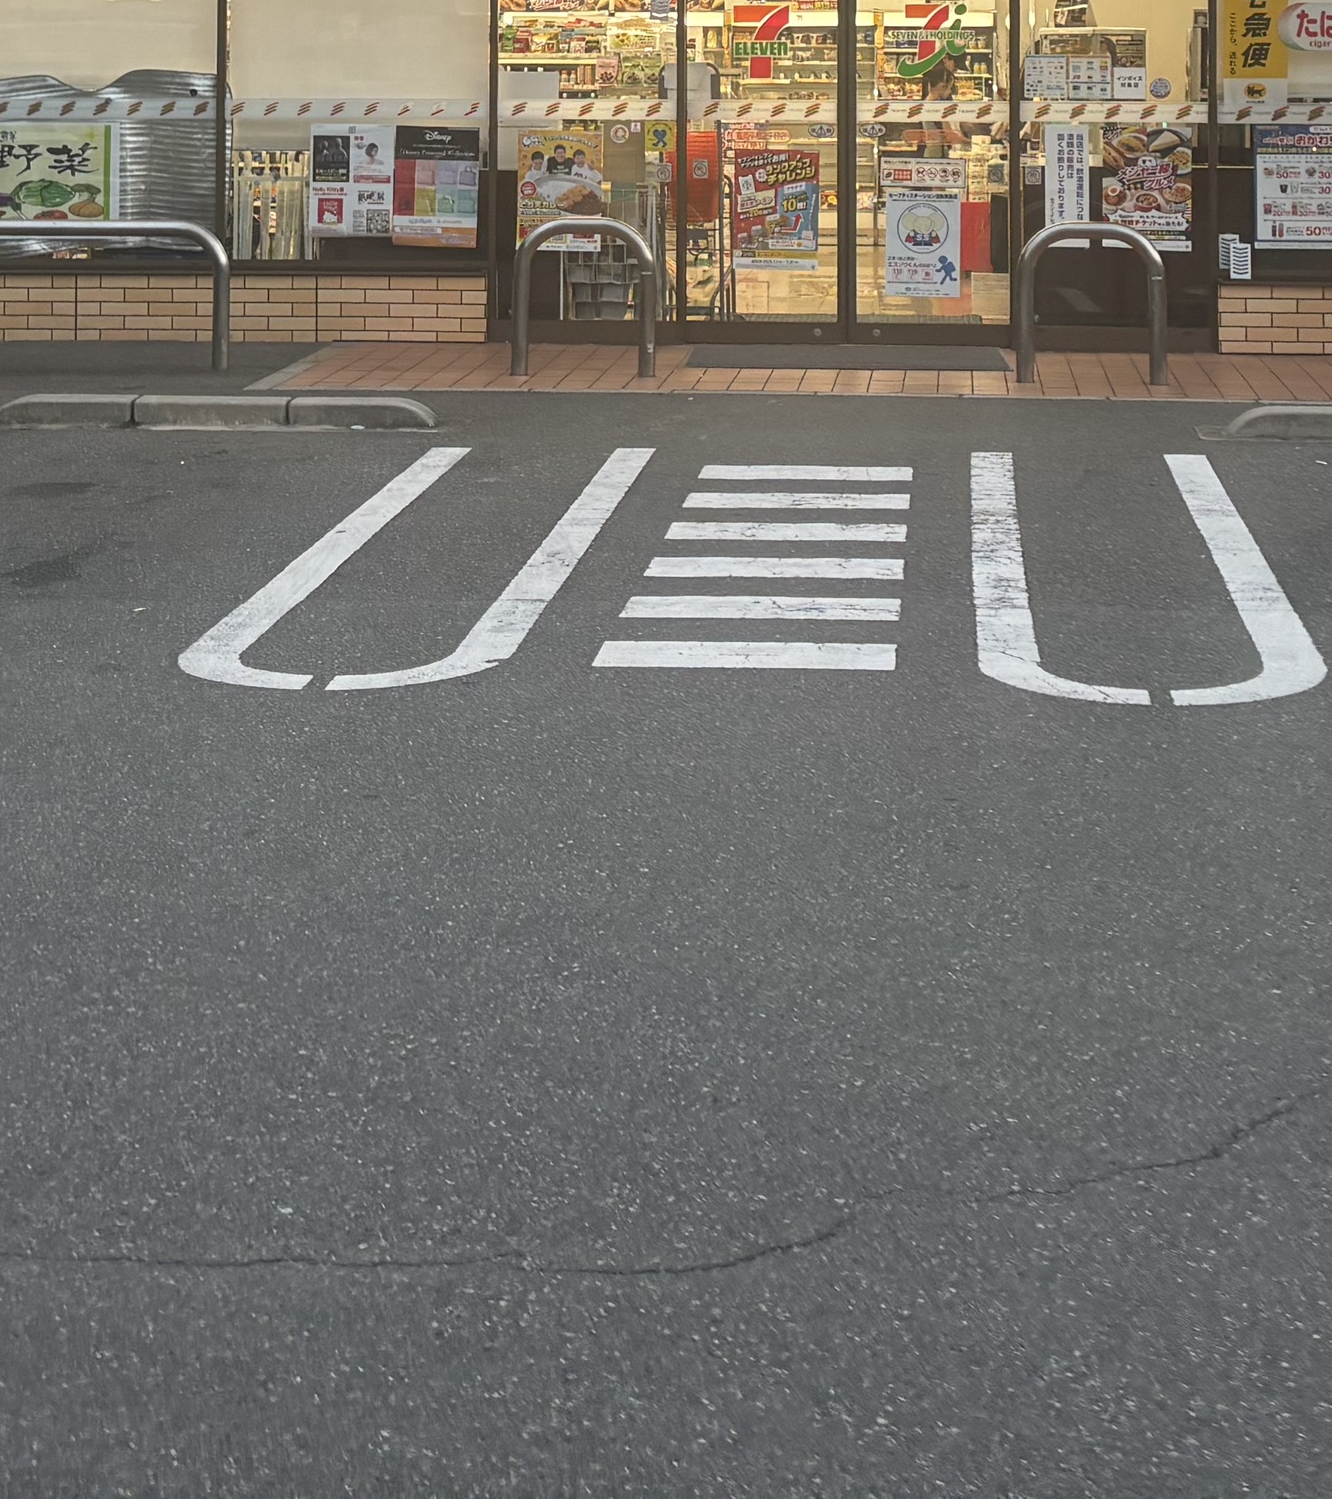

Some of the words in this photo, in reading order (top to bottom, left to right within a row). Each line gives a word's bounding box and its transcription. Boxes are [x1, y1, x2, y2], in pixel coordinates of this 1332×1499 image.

[931, 31, 975, 40] HOLDINGS
[423, 130, 452, 143] Disney
[1306, 226, 1321, 236] 50
